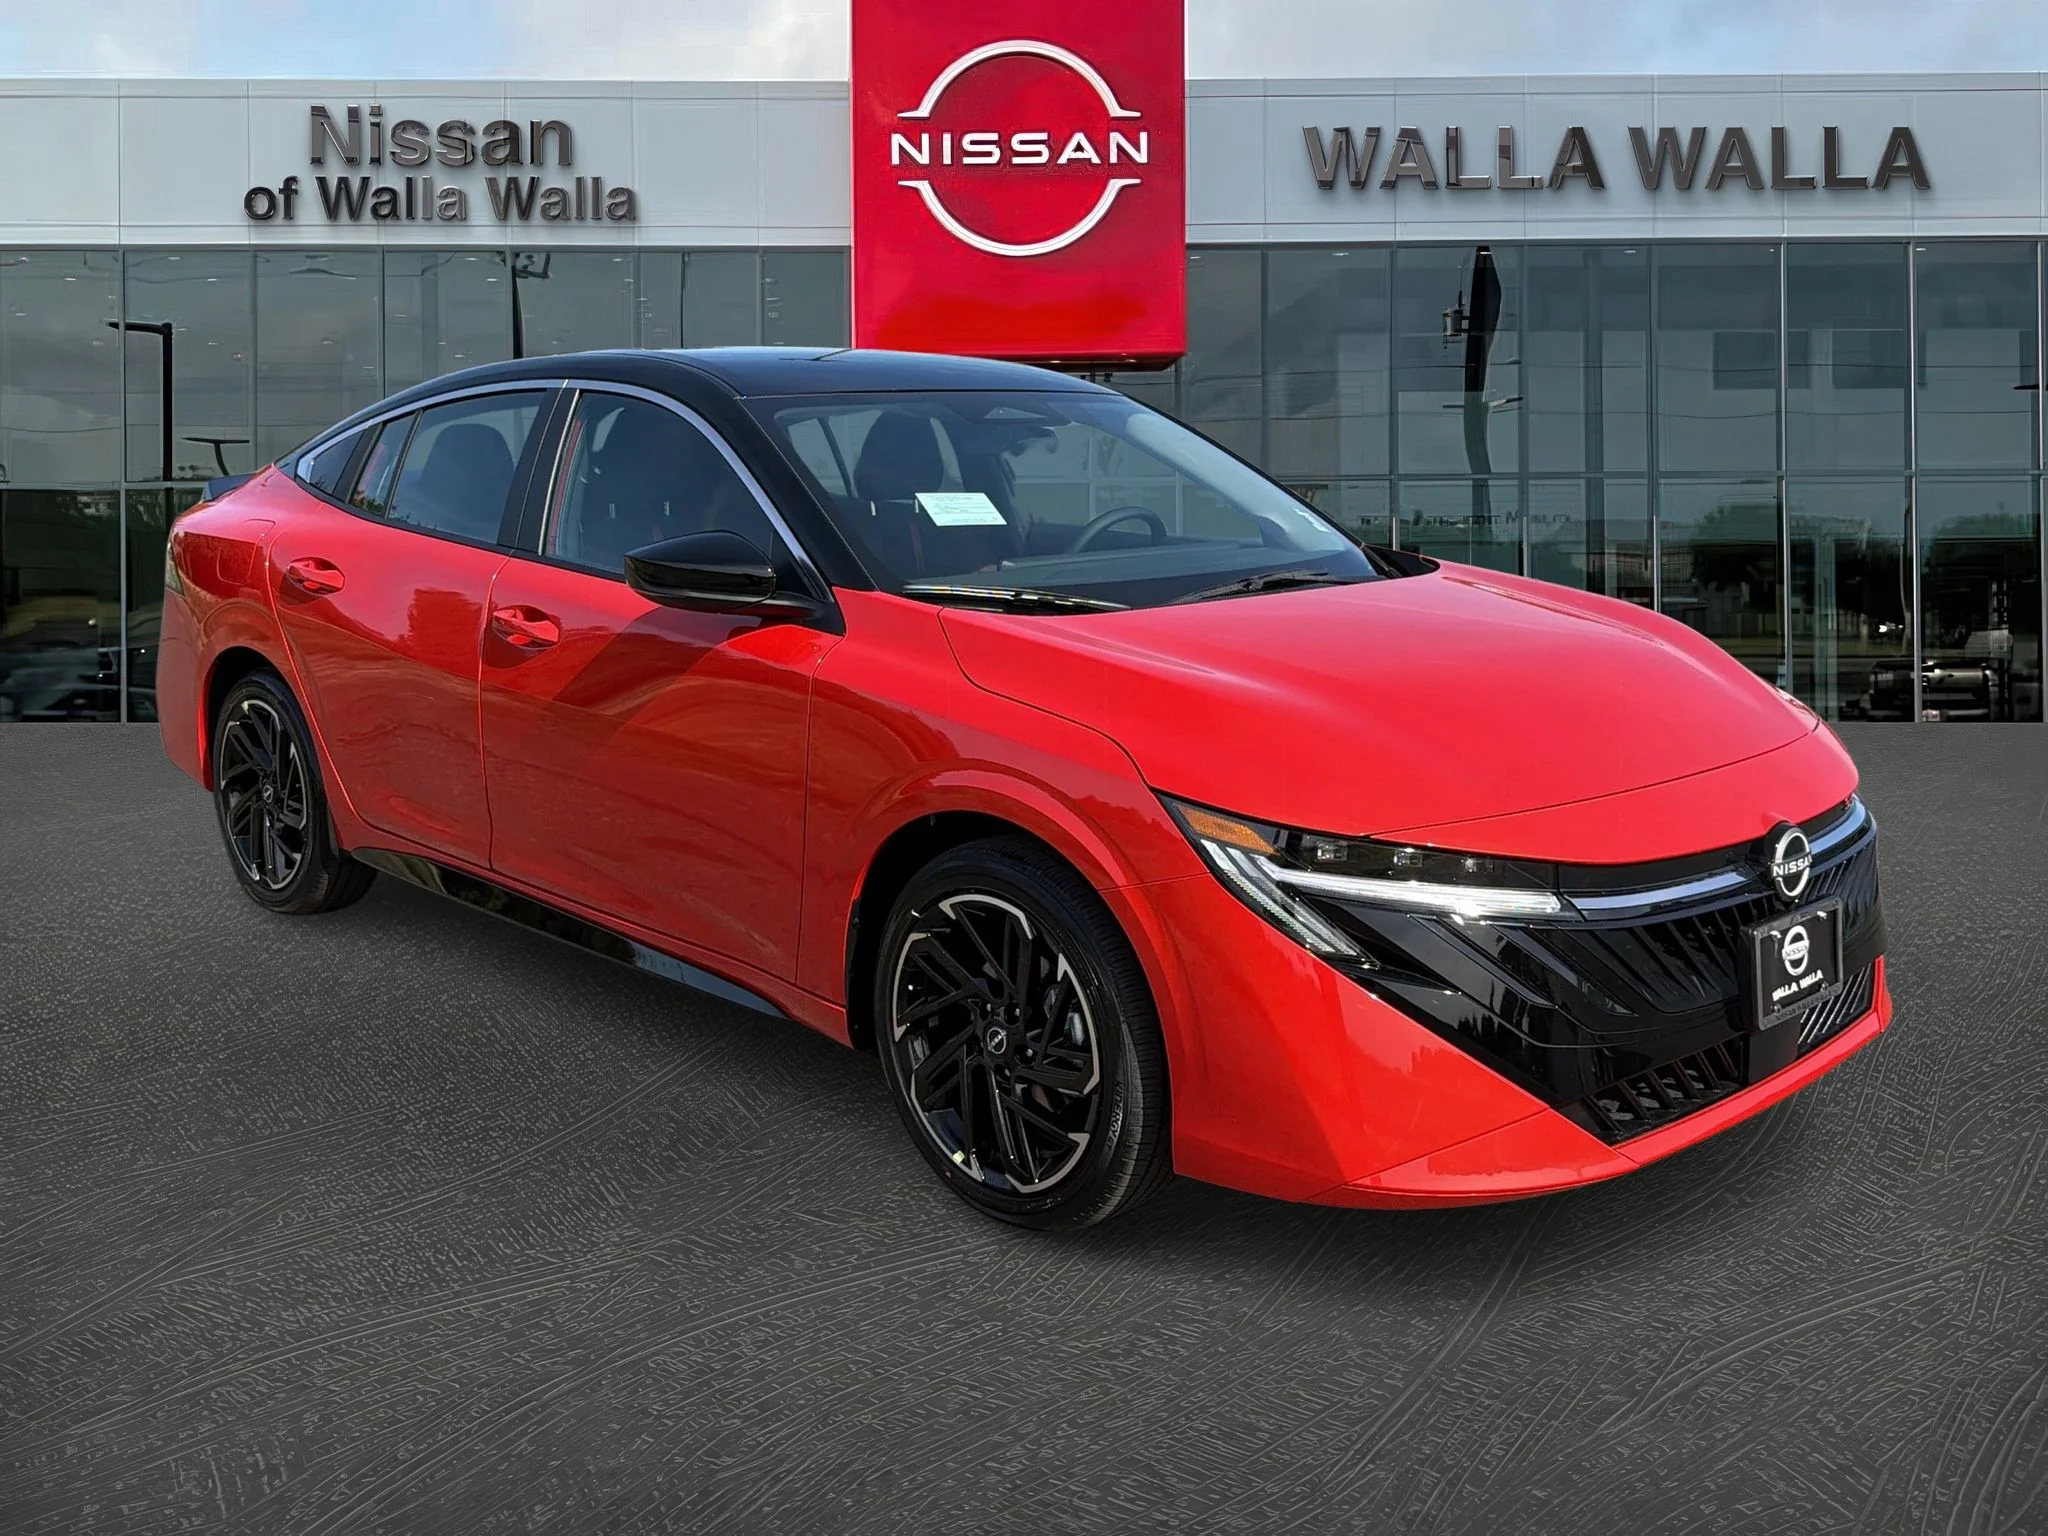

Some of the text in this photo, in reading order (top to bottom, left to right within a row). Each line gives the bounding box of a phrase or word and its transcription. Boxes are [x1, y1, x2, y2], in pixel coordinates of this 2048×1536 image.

[309, 103, 574, 167] Nissan
[890, 131, 1148, 165] NISSAN
[1302, 125, 1931, 190] WALLA WALLA
[243, 174, 638, 222] of Walla Walla
